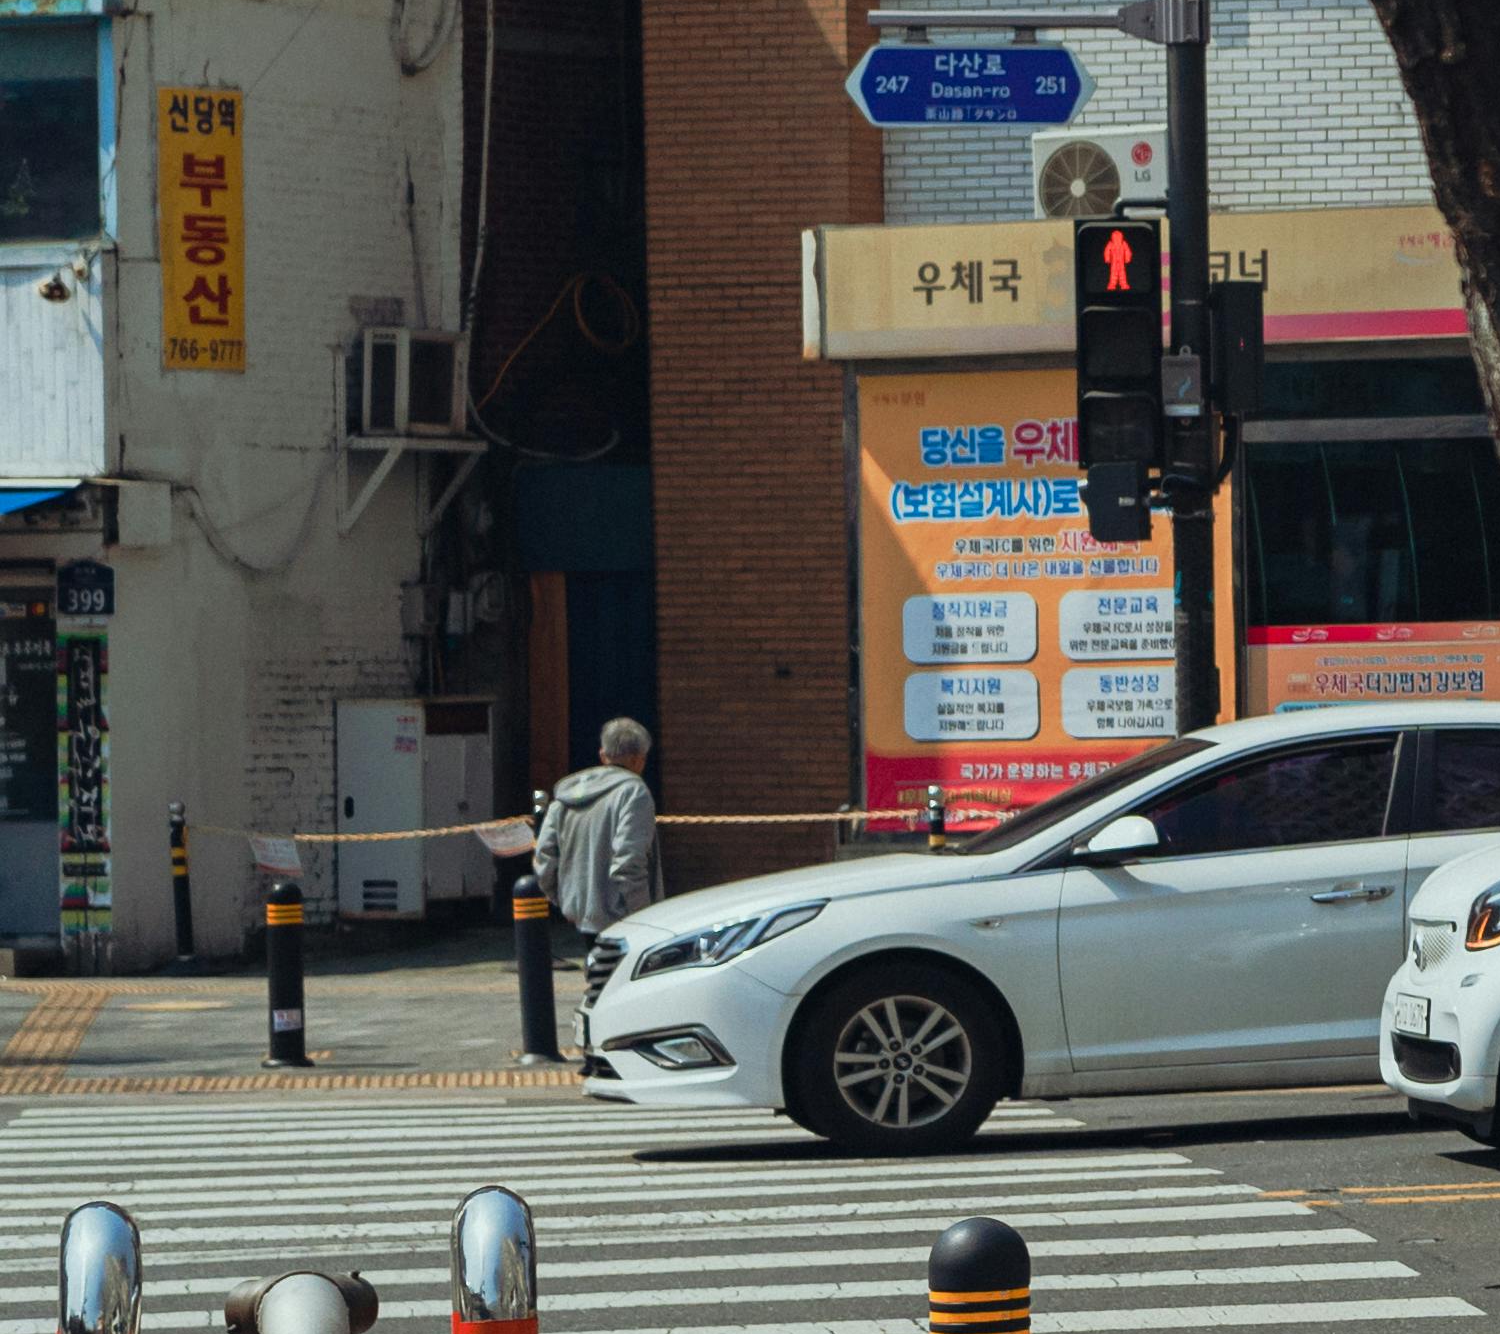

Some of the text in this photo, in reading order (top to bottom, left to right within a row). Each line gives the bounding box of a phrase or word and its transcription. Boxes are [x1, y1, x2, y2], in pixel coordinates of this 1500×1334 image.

[935, 52, 1006, 79] 다산로
[875, 75, 1067, 99] 247 Dasan-ro 251
[168, 94, 236, 136] 신당역
[1135, 171, 1151, 182] LG
[179, 152, 233, 328] 부동산
[913, 258, 1022, 306] 우체국
[921, 426, 1005, 465] 당신을
[67, 587, 106, 612] 399
